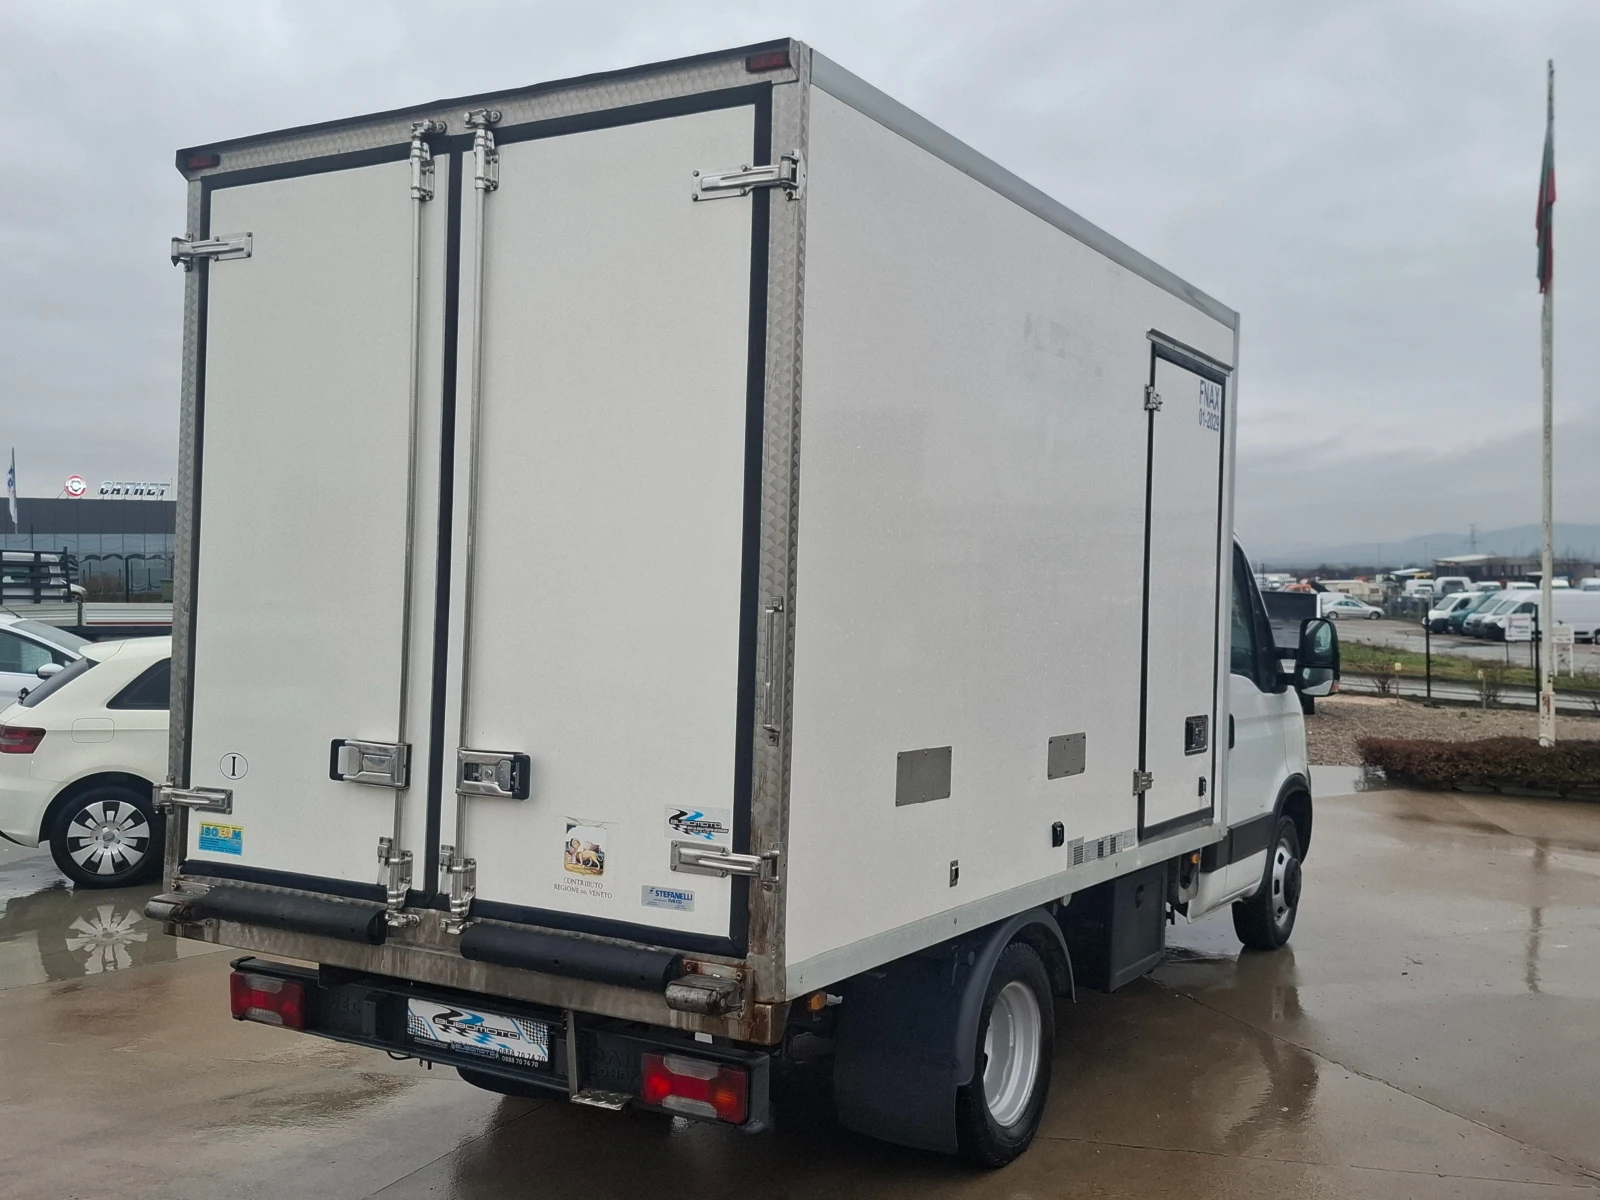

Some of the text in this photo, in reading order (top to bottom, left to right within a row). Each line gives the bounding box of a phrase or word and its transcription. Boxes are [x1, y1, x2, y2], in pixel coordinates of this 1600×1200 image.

[1199, 379, 1220, 412] FNAX
[1199, 408, 1220, 432] 01-2029
[231, 756, 237, 776] I
[553, 883, 580, 894] REGIONE
[588, 890, 613, 899] VENETO
[563, 877, 604, 889] CONTRIBUTO
[655, 890, 693, 901] STEFANELLI
